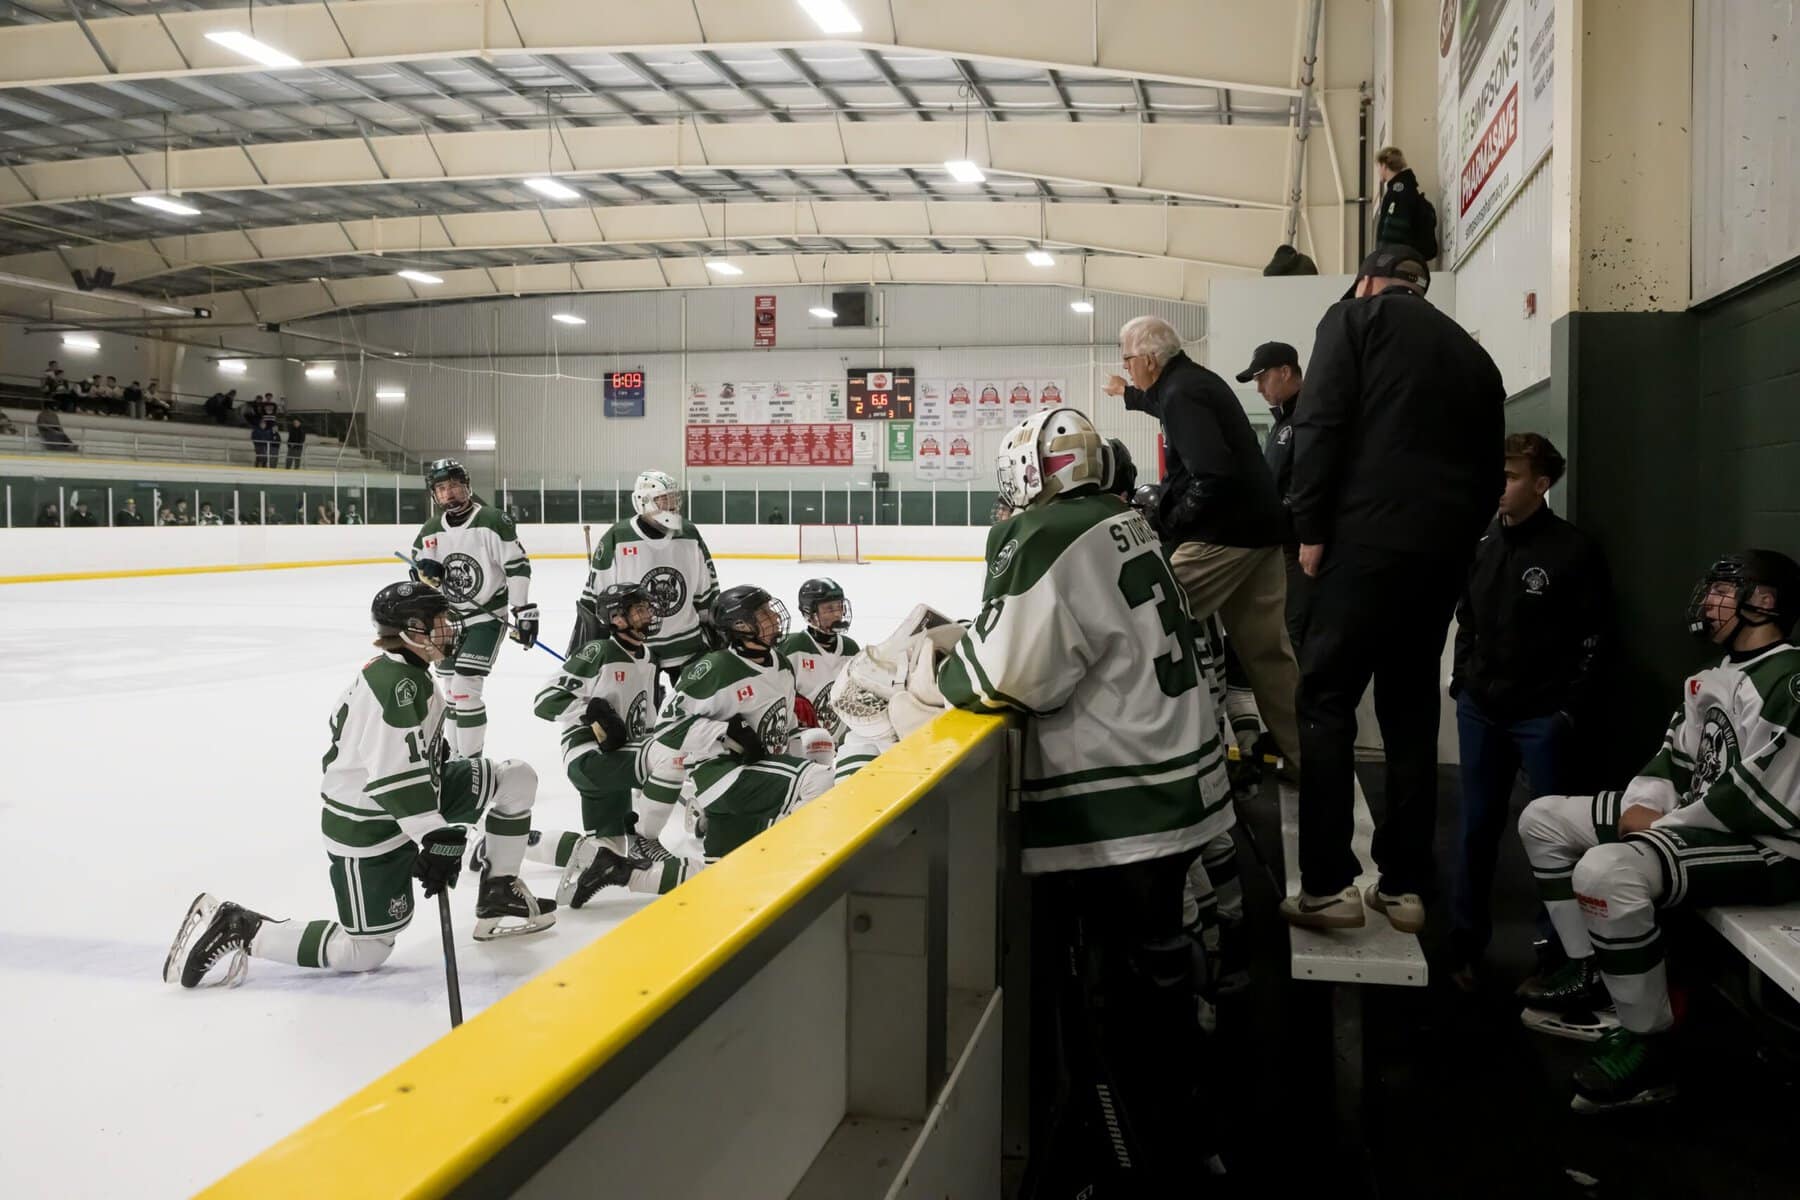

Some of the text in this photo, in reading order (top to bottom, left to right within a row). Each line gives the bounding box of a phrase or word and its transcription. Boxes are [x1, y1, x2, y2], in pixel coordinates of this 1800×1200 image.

[1470, 26, 1518, 141] SIMPSON'S
[1462, 96, 1516, 211] PHARMASAVE
[613, 373, 641, 388] 6:09
[856, 402, 863, 414] 2
[872, 394, 888, 406] 6.6
[889, 410, 895, 418] 3
[471, 760, 481, 796] BAUE
[1095, 1083, 1132, 1169] WARRIOR
